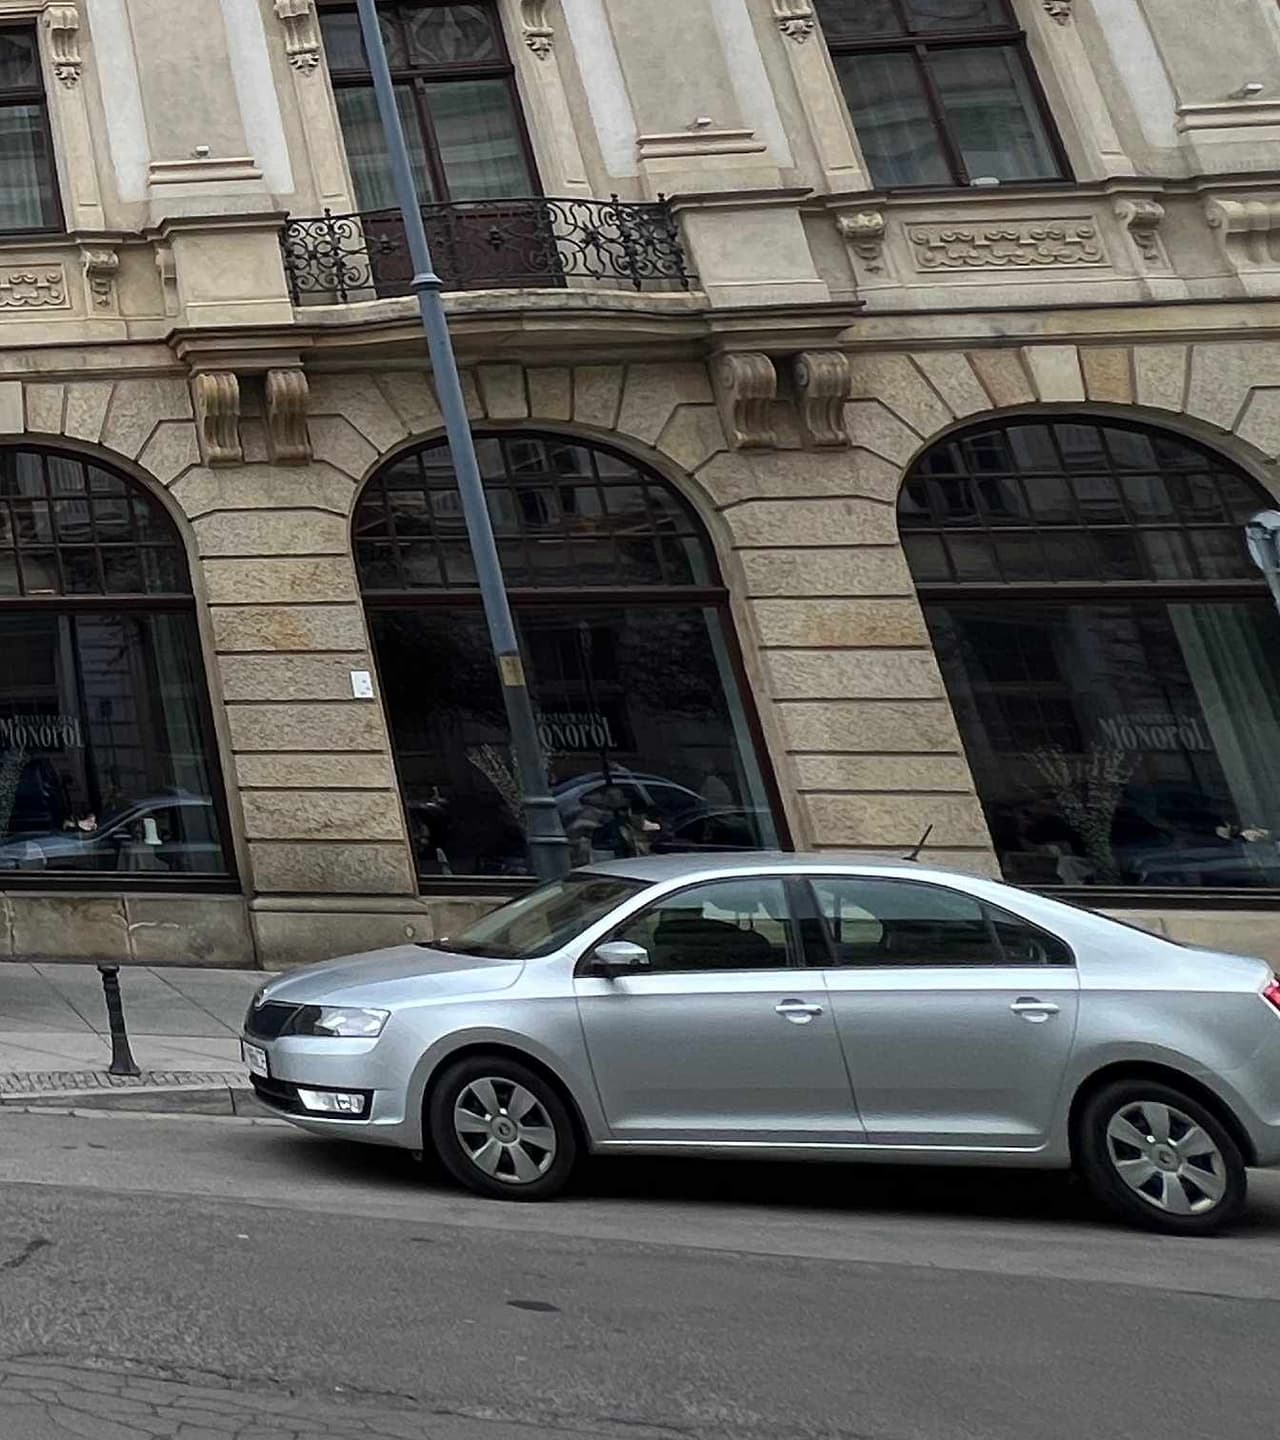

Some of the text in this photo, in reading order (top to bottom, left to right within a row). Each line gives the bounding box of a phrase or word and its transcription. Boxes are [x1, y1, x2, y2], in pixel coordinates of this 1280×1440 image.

[0, 718, 85, 748] MONOPOL
[539, 716, 617, 750] ONOPOL
[1098, 717, 1212, 750] MONOPOL
